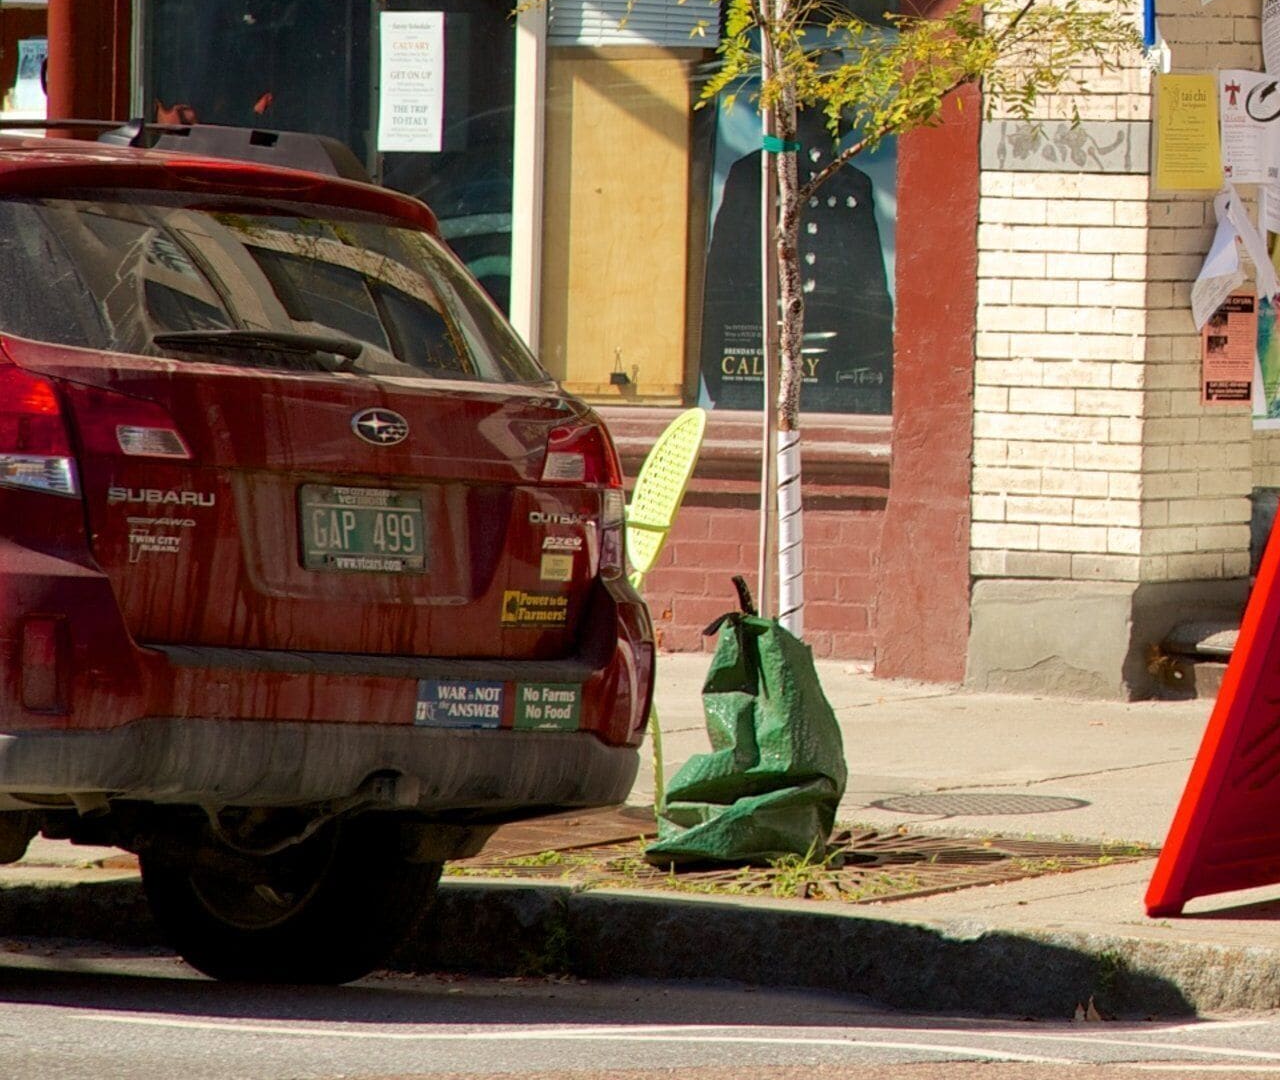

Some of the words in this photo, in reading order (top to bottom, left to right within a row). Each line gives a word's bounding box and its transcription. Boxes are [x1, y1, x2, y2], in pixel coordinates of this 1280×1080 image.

[721, 357, 820, 378] CALY
[108, 487, 215, 507] SUBARU
[312, 509, 356, 550] GAP
[373, 512, 416, 552] 499
[129, 535, 156, 545] TWIN
[157, 536, 180, 545] CITY
[140, 545, 180, 553] SUBARU
[519, 592, 548, 606] Power
[518, 607, 568, 621] Farmers!
[438, 686, 467, 701] WAR
[475, 687, 502, 701] NOT
[523, 687, 540, 701] No
[542, 687, 576, 703] Farms
[449, 703, 500, 719] ANSWER
[525, 704, 542, 719] No
[544, 704, 572, 719] Food
